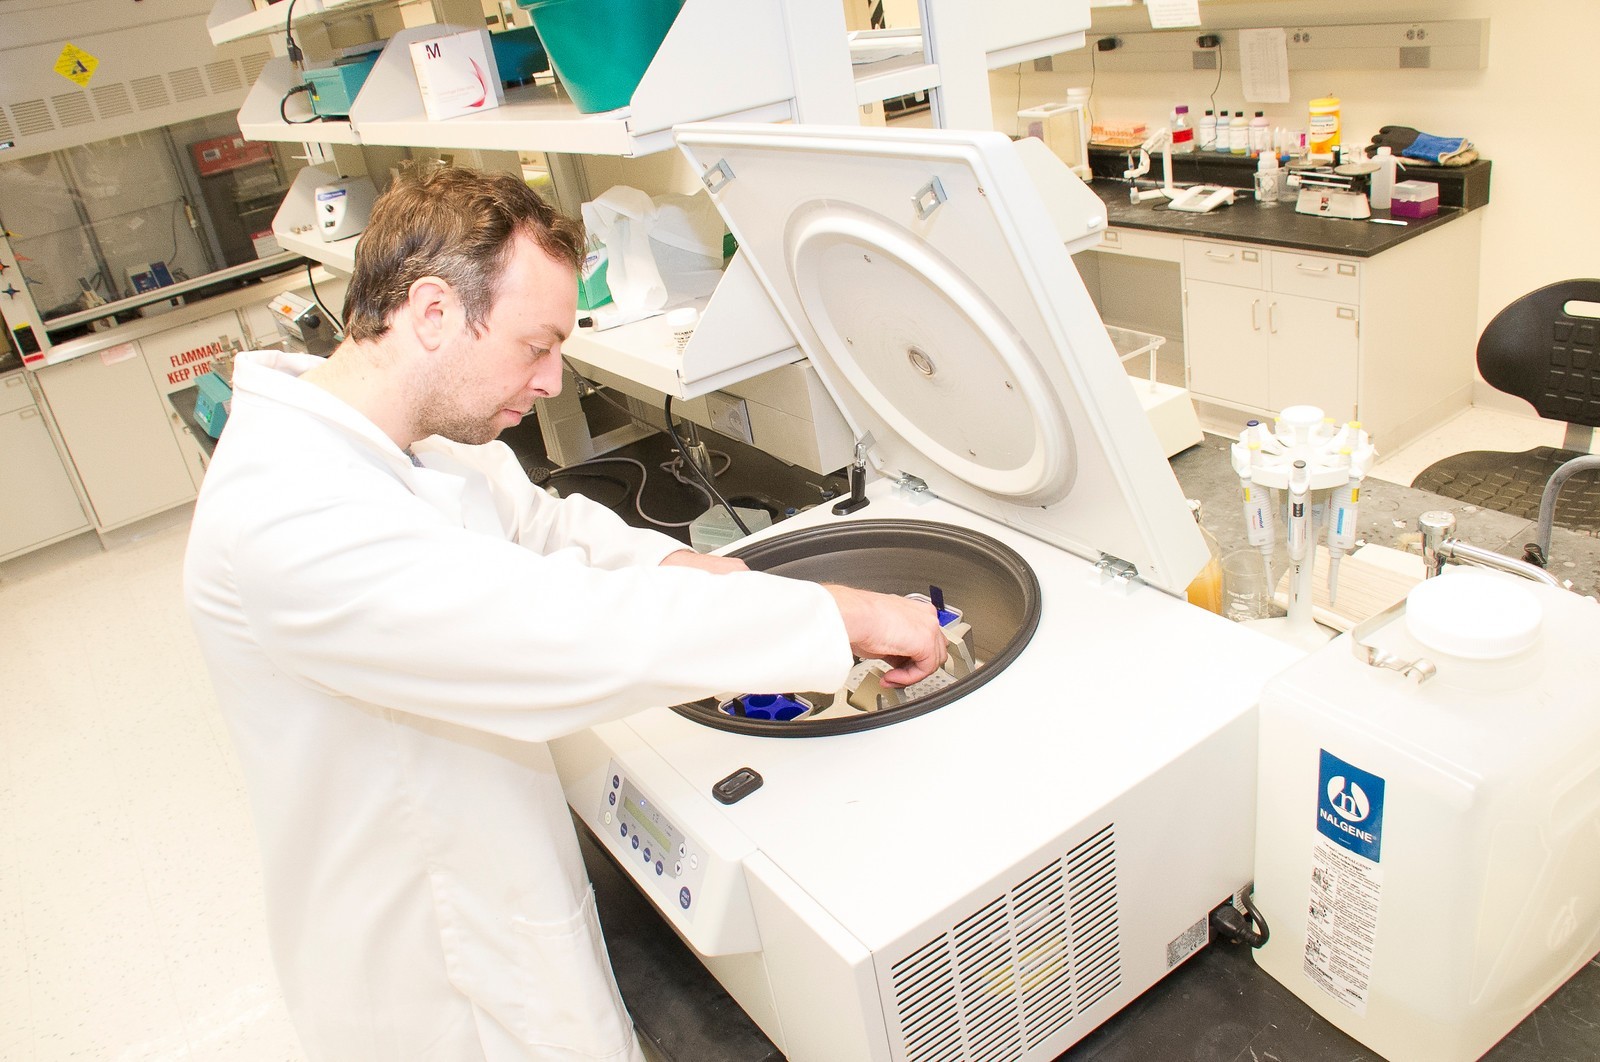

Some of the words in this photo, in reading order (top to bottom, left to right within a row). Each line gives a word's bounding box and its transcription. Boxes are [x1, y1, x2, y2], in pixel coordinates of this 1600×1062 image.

[425, 42, 441, 60] M
[170, 342, 223, 367] FLAMMABL
[167, 367, 191, 385] KEEP
[1319, 807, 1373, 844] NALGENE
